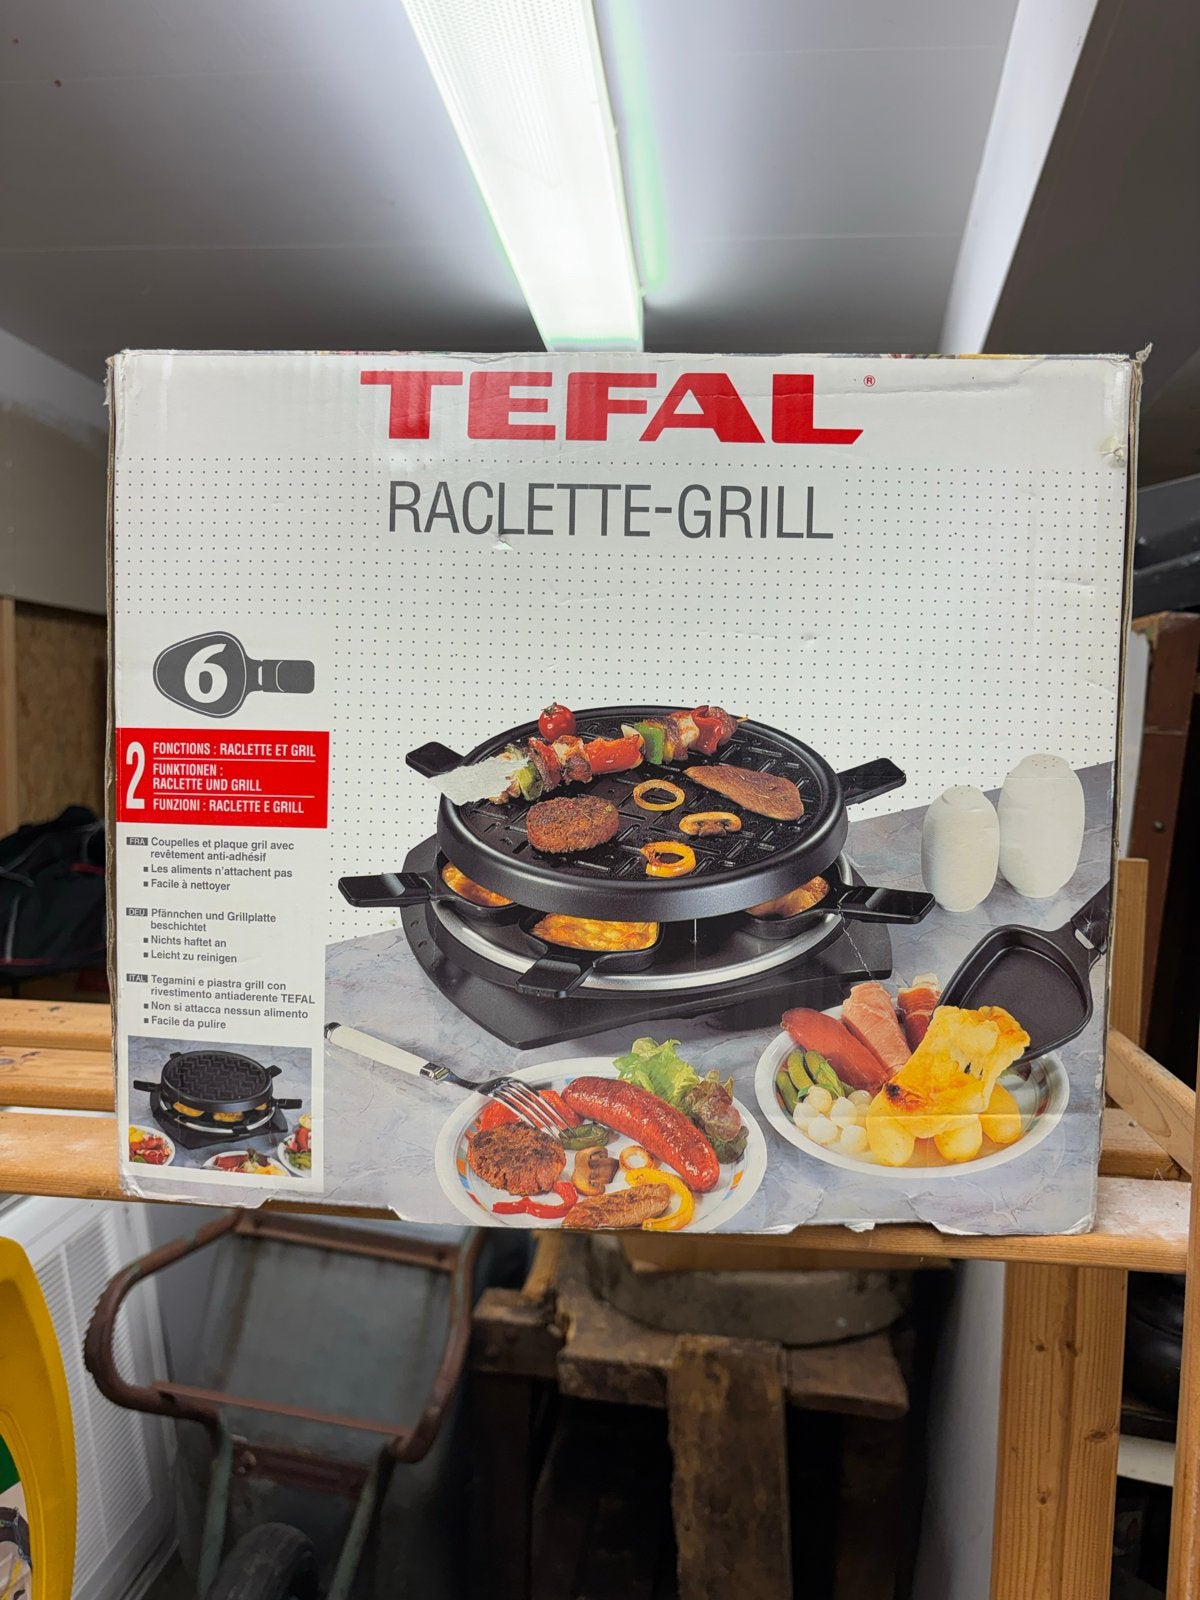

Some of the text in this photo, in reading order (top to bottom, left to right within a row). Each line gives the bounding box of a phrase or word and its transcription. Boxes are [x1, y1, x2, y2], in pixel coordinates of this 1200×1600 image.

[360, 370, 864, 445] TEFAL
[389, 480, 833, 539] RACLETTE-GRILL
[184, 643, 228, 703] 6
[153, 742, 211, 755] FONCTIONS
[220, 744, 273, 756] RACLETTE
[276, 745, 288, 756] ET
[291, 745, 316, 757] GRIL
[126, 741, 145, 810] 2
[153, 764, 217, 776] FUNKTIONEN
[153, 778, 262, 791] RACLETTE UND GRILL
[153, 799, 200, 811] FUNZIONI
[209, 800, 261, 812] RACLETTE
[264, 801, 270, 812] E
[273, 801, 304, 813] GRILL
[151, 837, 294, 851] Coupelles et plaque gril avec
[151, 850, 267, 862] revêtement anti-adhésif
[151, 865, 293, 878] Les aliments n'attachent pas
[151, 879, 230, 892] Facile à nettoyer
[128, 908, 146, 917] DEU
[151, 909, 276, 923] Pfännchen und Grillplatte
[151, 921, 206, 931] beschichtet
[151, 936, 226, 947] Nichts haftet an
[151, 950, 237, 964] Leicht zu reinigen
[151, 975, 195, 986] Tegamini
[207, 978, 242, 989] piastra
[245, 980, 264, 991] grill
[267, 982, 286, 990] con
[151, 988, 315, 1004] rivestimento antiaderente TEFAL
[151, 1001, 308, 1018] Non si attacca nessun alimento
[151, 1016, 226, 1029] Facile da pulire
